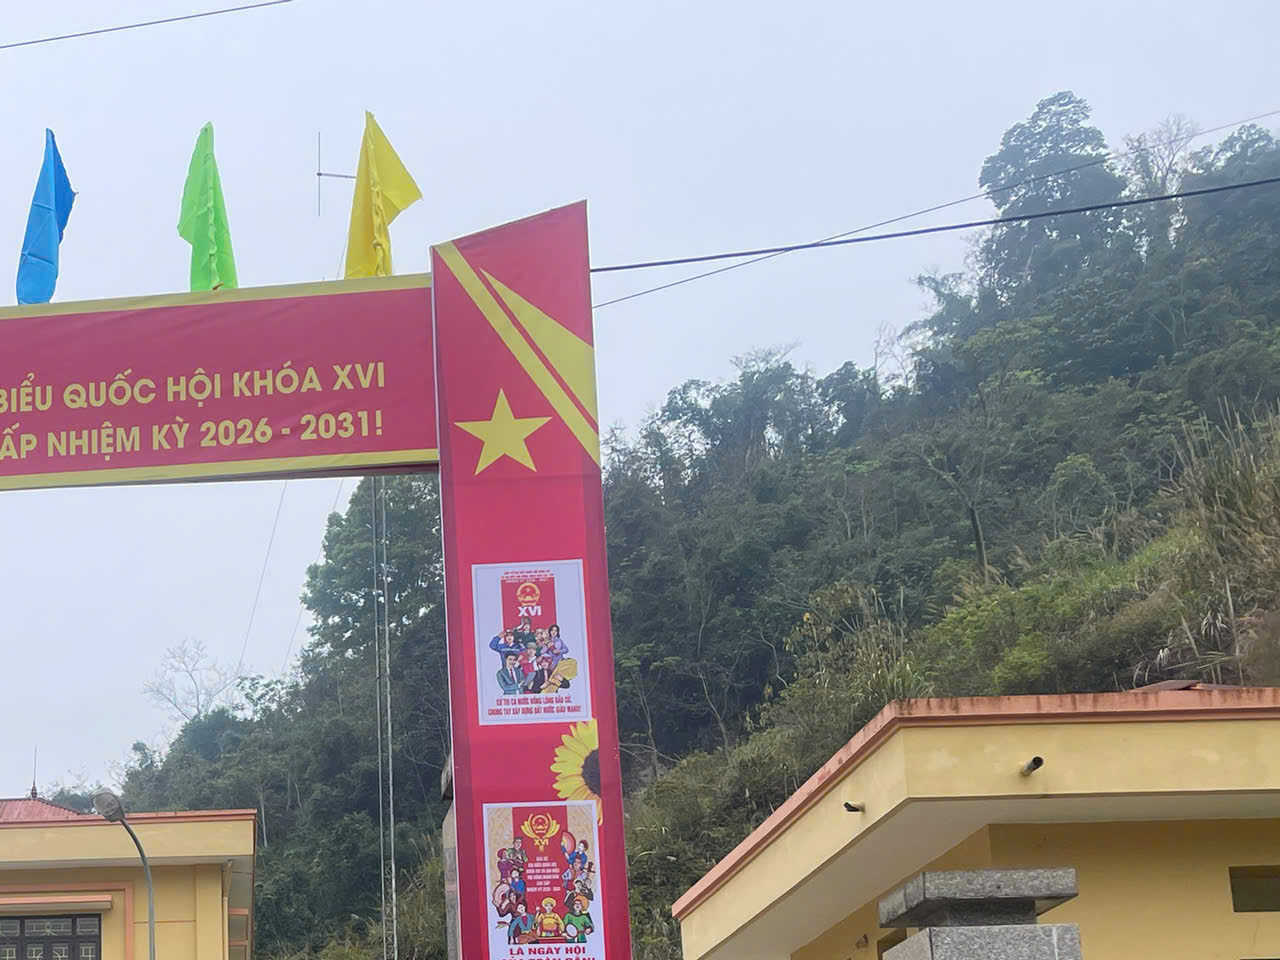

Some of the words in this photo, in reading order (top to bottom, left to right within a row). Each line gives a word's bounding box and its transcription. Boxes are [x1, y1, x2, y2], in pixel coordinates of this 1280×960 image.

[63, 368, 156, 409] QUỐC
[167, 367, 221, 407] HỘI
[232, 360, 322, 397] KHÓA
[332, 361, 385, 391] XVI
[47, 421, 140, 461] NHIỆM
[152, 415, 190, 450] KỲ
[199, 417, 273, 447] 2026
[281, 427, 291, 435] -
[300, 410, 383, 441] 2031!
[517, 605, 542, 617] XVI
[534, 838, 549, 846] XVI
[509, 946, 524, 955] LÀ
[528, 945, 561, 955] NGÀY
[565, 944, 586, 955] HỘI
